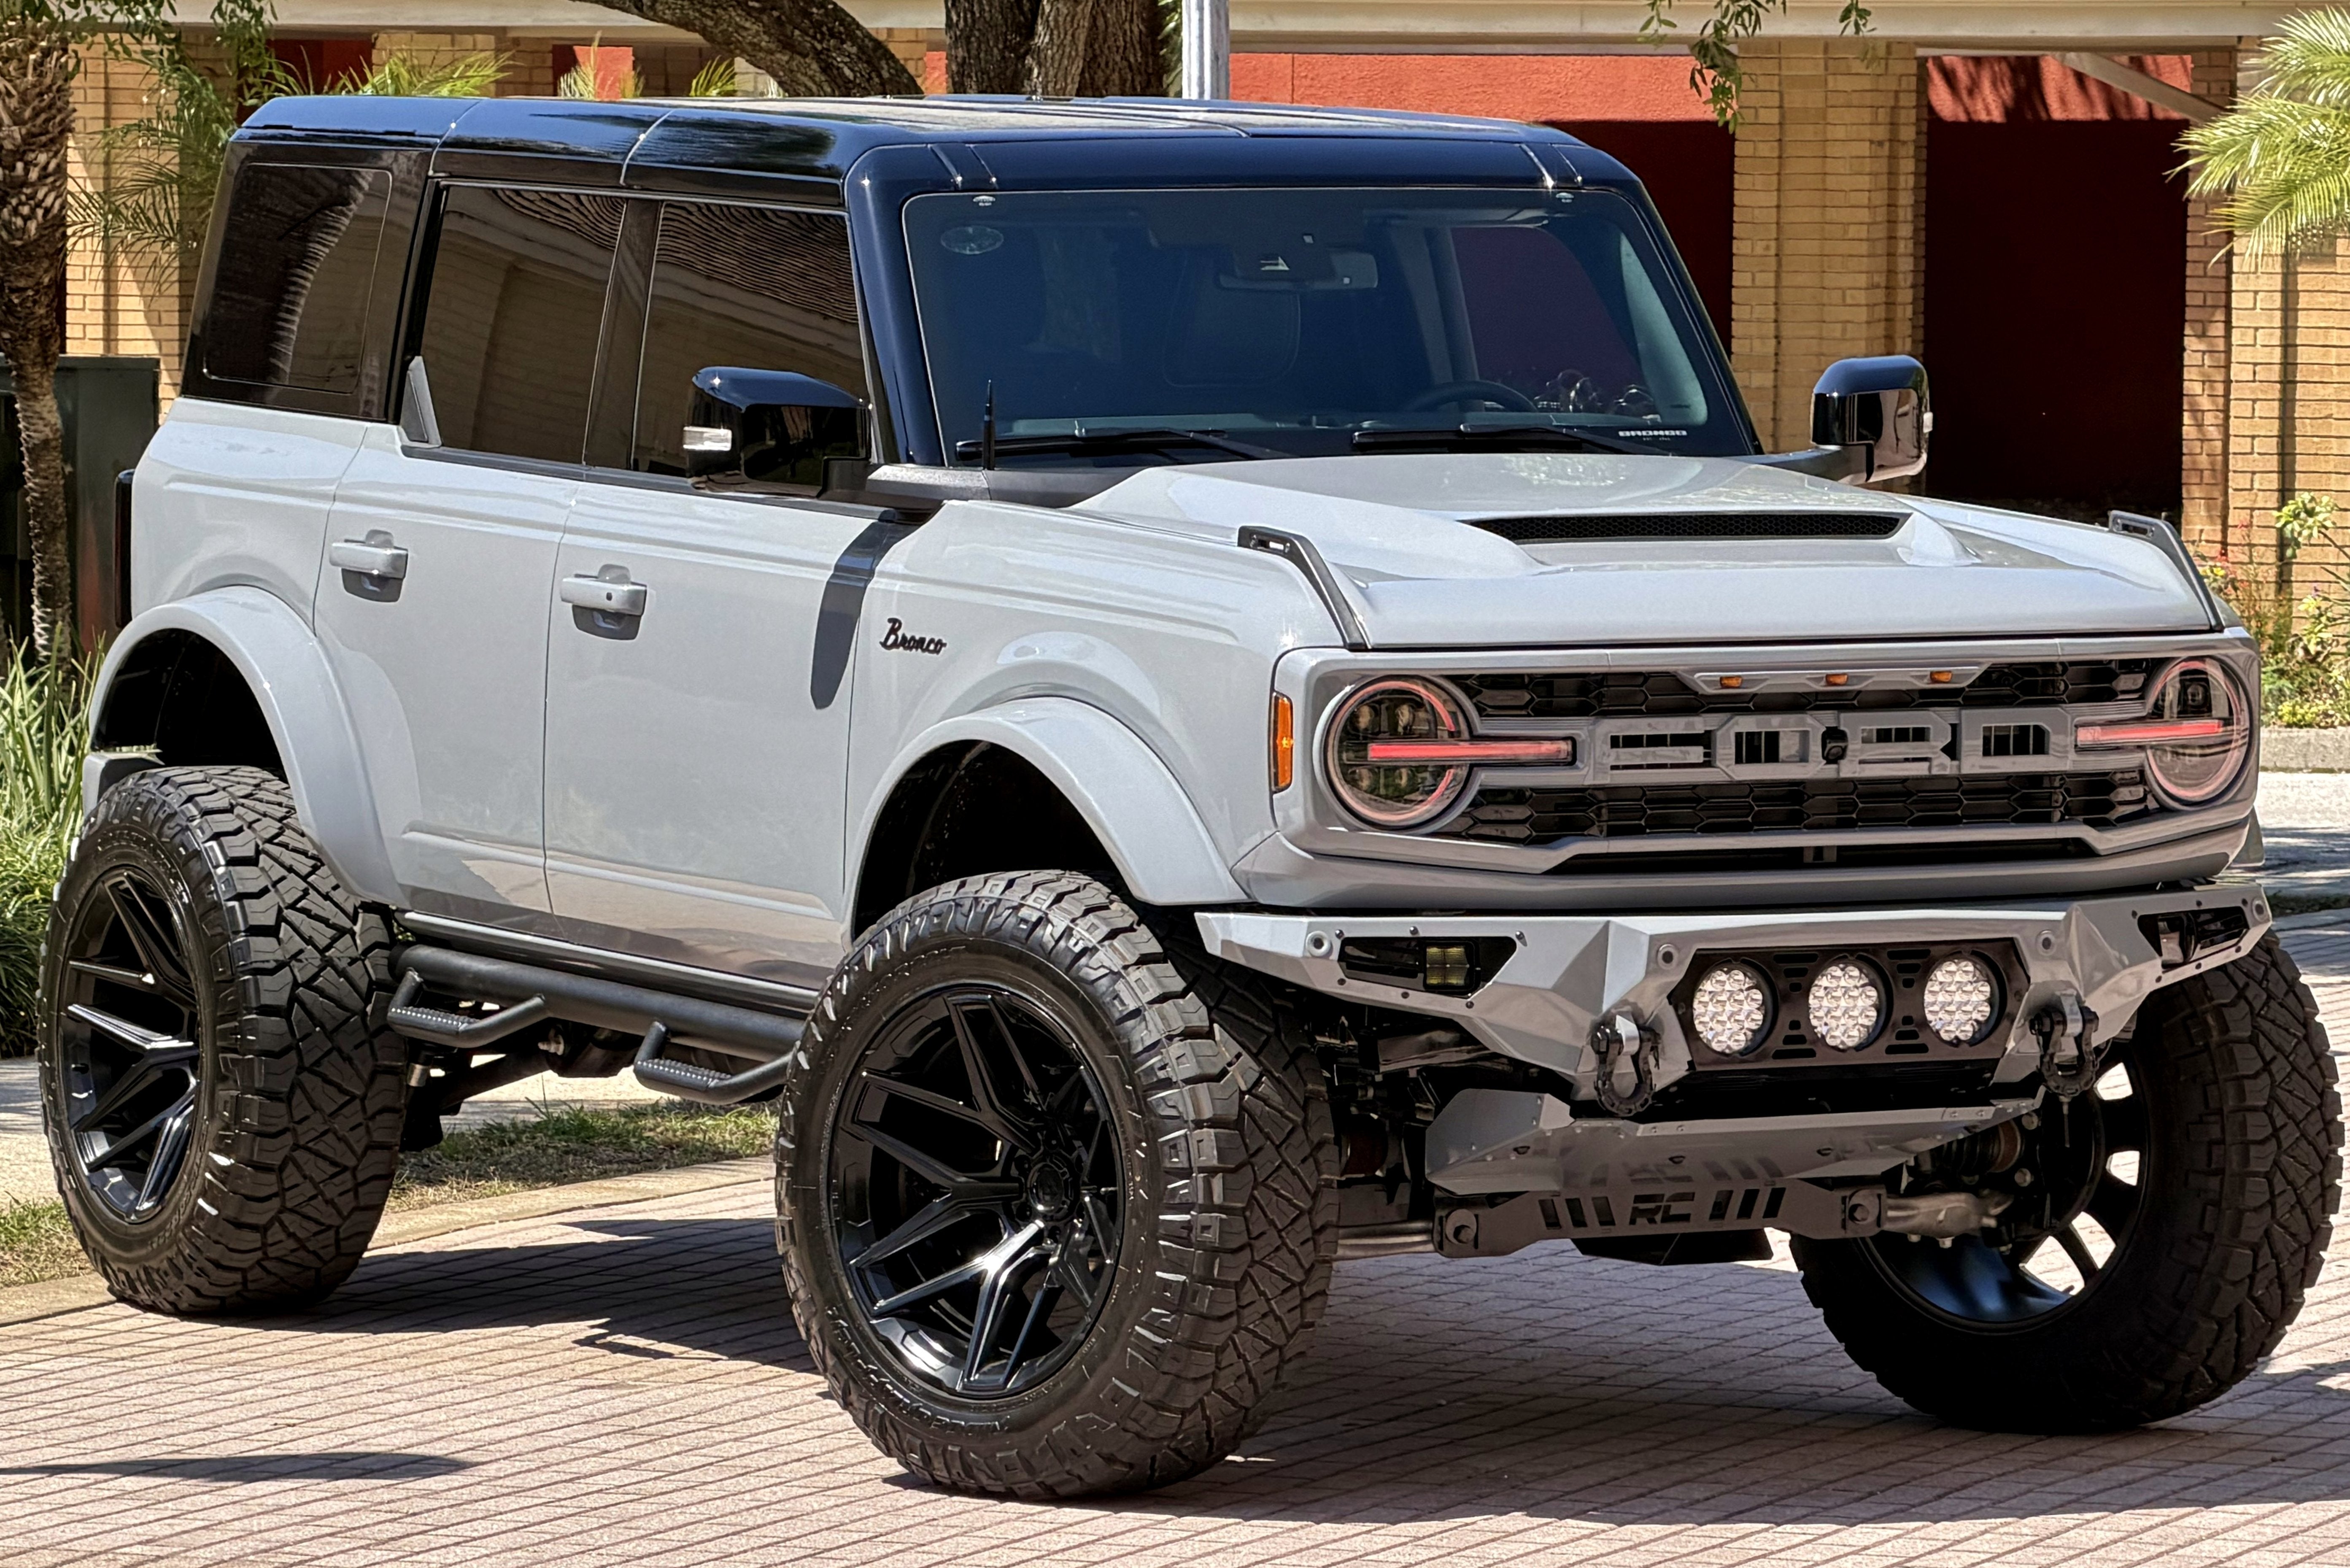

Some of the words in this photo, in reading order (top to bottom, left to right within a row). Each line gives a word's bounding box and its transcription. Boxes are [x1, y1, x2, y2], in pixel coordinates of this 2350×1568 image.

[879, 618, 947, 655] Bronco
[1591, 707, 2071, 784] FORD
[1629, 1192, 1695, 1225] RC
